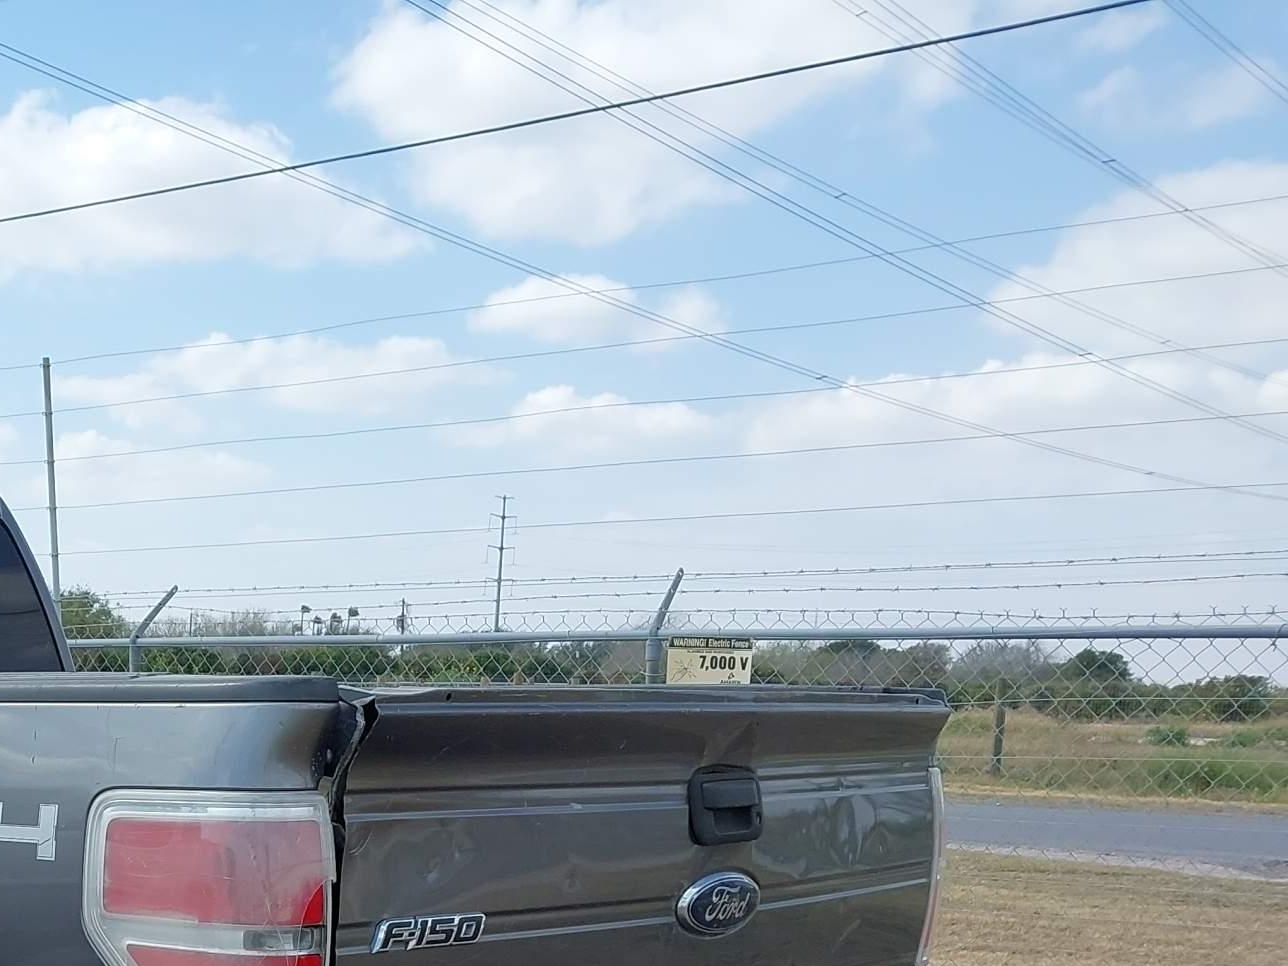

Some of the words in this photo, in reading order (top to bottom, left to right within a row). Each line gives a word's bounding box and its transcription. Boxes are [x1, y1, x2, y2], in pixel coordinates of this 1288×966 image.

[673, 637, 707, 648] WARNING!
[708, 638, 731, 649] Electric
[731, 639, 750, 649] Fence
[699, 655, 736, 671] 7,000
[740, 657, 749, 670] V
[705, 885, 750, 922] Ford
[371, 913, 486, 953] F-150
